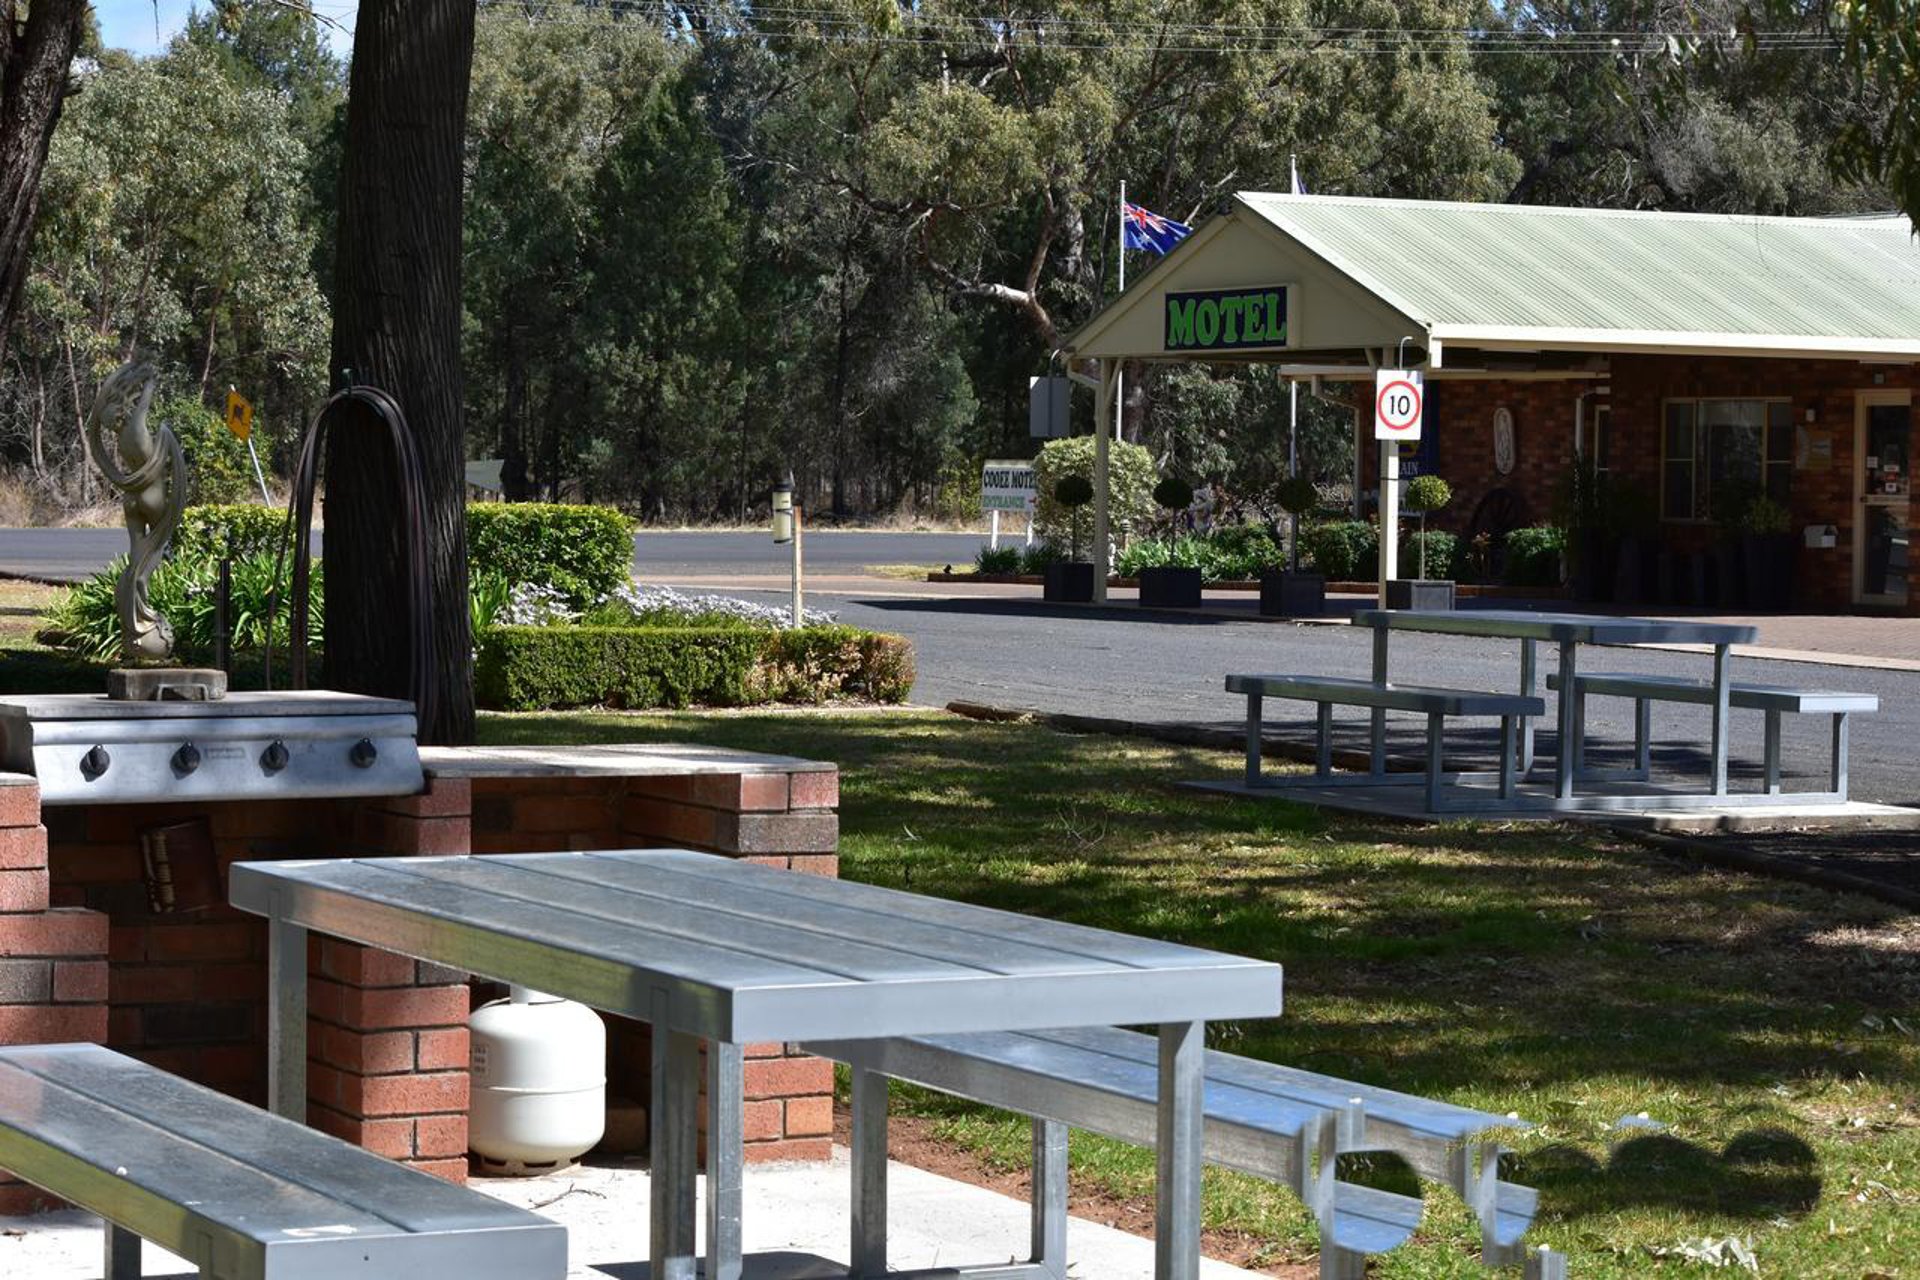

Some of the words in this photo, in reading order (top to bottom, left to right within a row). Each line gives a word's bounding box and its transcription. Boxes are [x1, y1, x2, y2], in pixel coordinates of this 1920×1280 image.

[1168, 293, 1286, 346] MOTEL
[1390, 396, 1410, 416] 10
[984, 470, 1010, 489] COOEE
